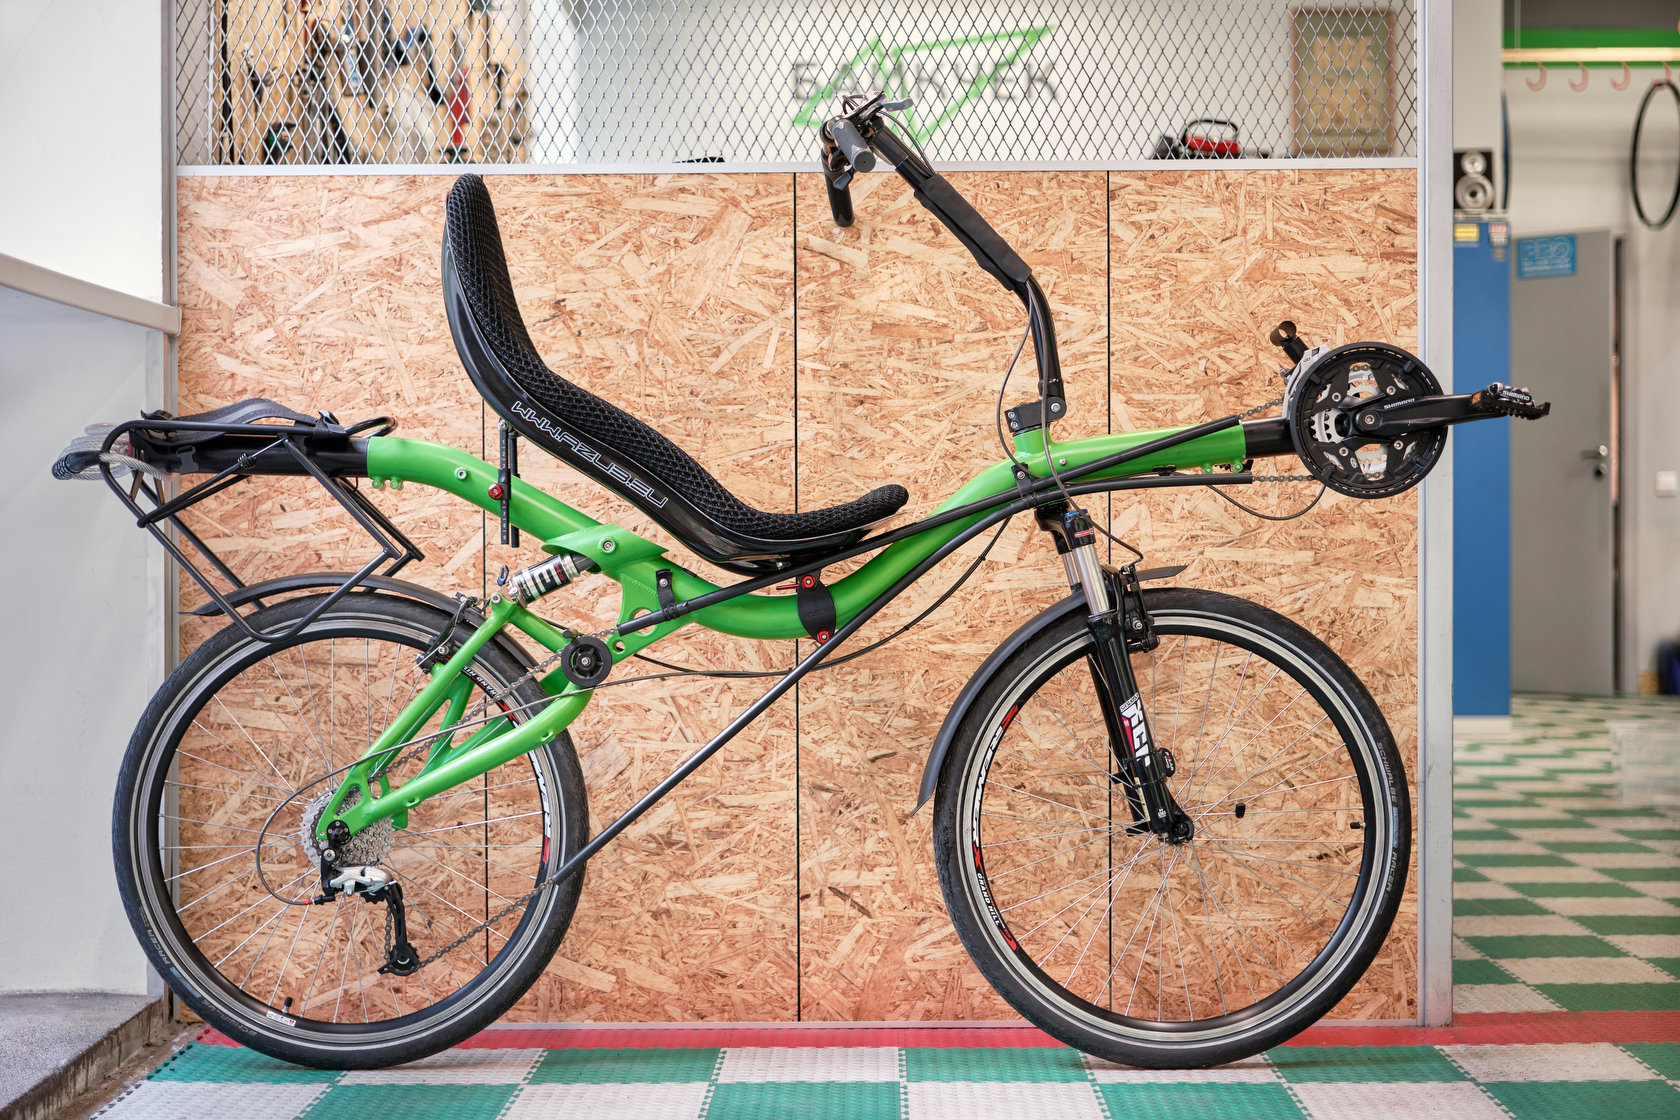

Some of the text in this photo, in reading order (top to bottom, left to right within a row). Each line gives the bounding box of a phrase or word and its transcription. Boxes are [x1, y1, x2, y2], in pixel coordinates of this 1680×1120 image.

[1383, 397, 1415, 410] SHIMANO
[511, 401, 668, 509] WWW.AZUB.EU
[1376, 740, 1397, 803] SCHWALBE
[1384, 851, 1398, 892] RACER
[976, 872, 1001, 926] GRAND HILL
[145, 927, 171, 965] RACER
